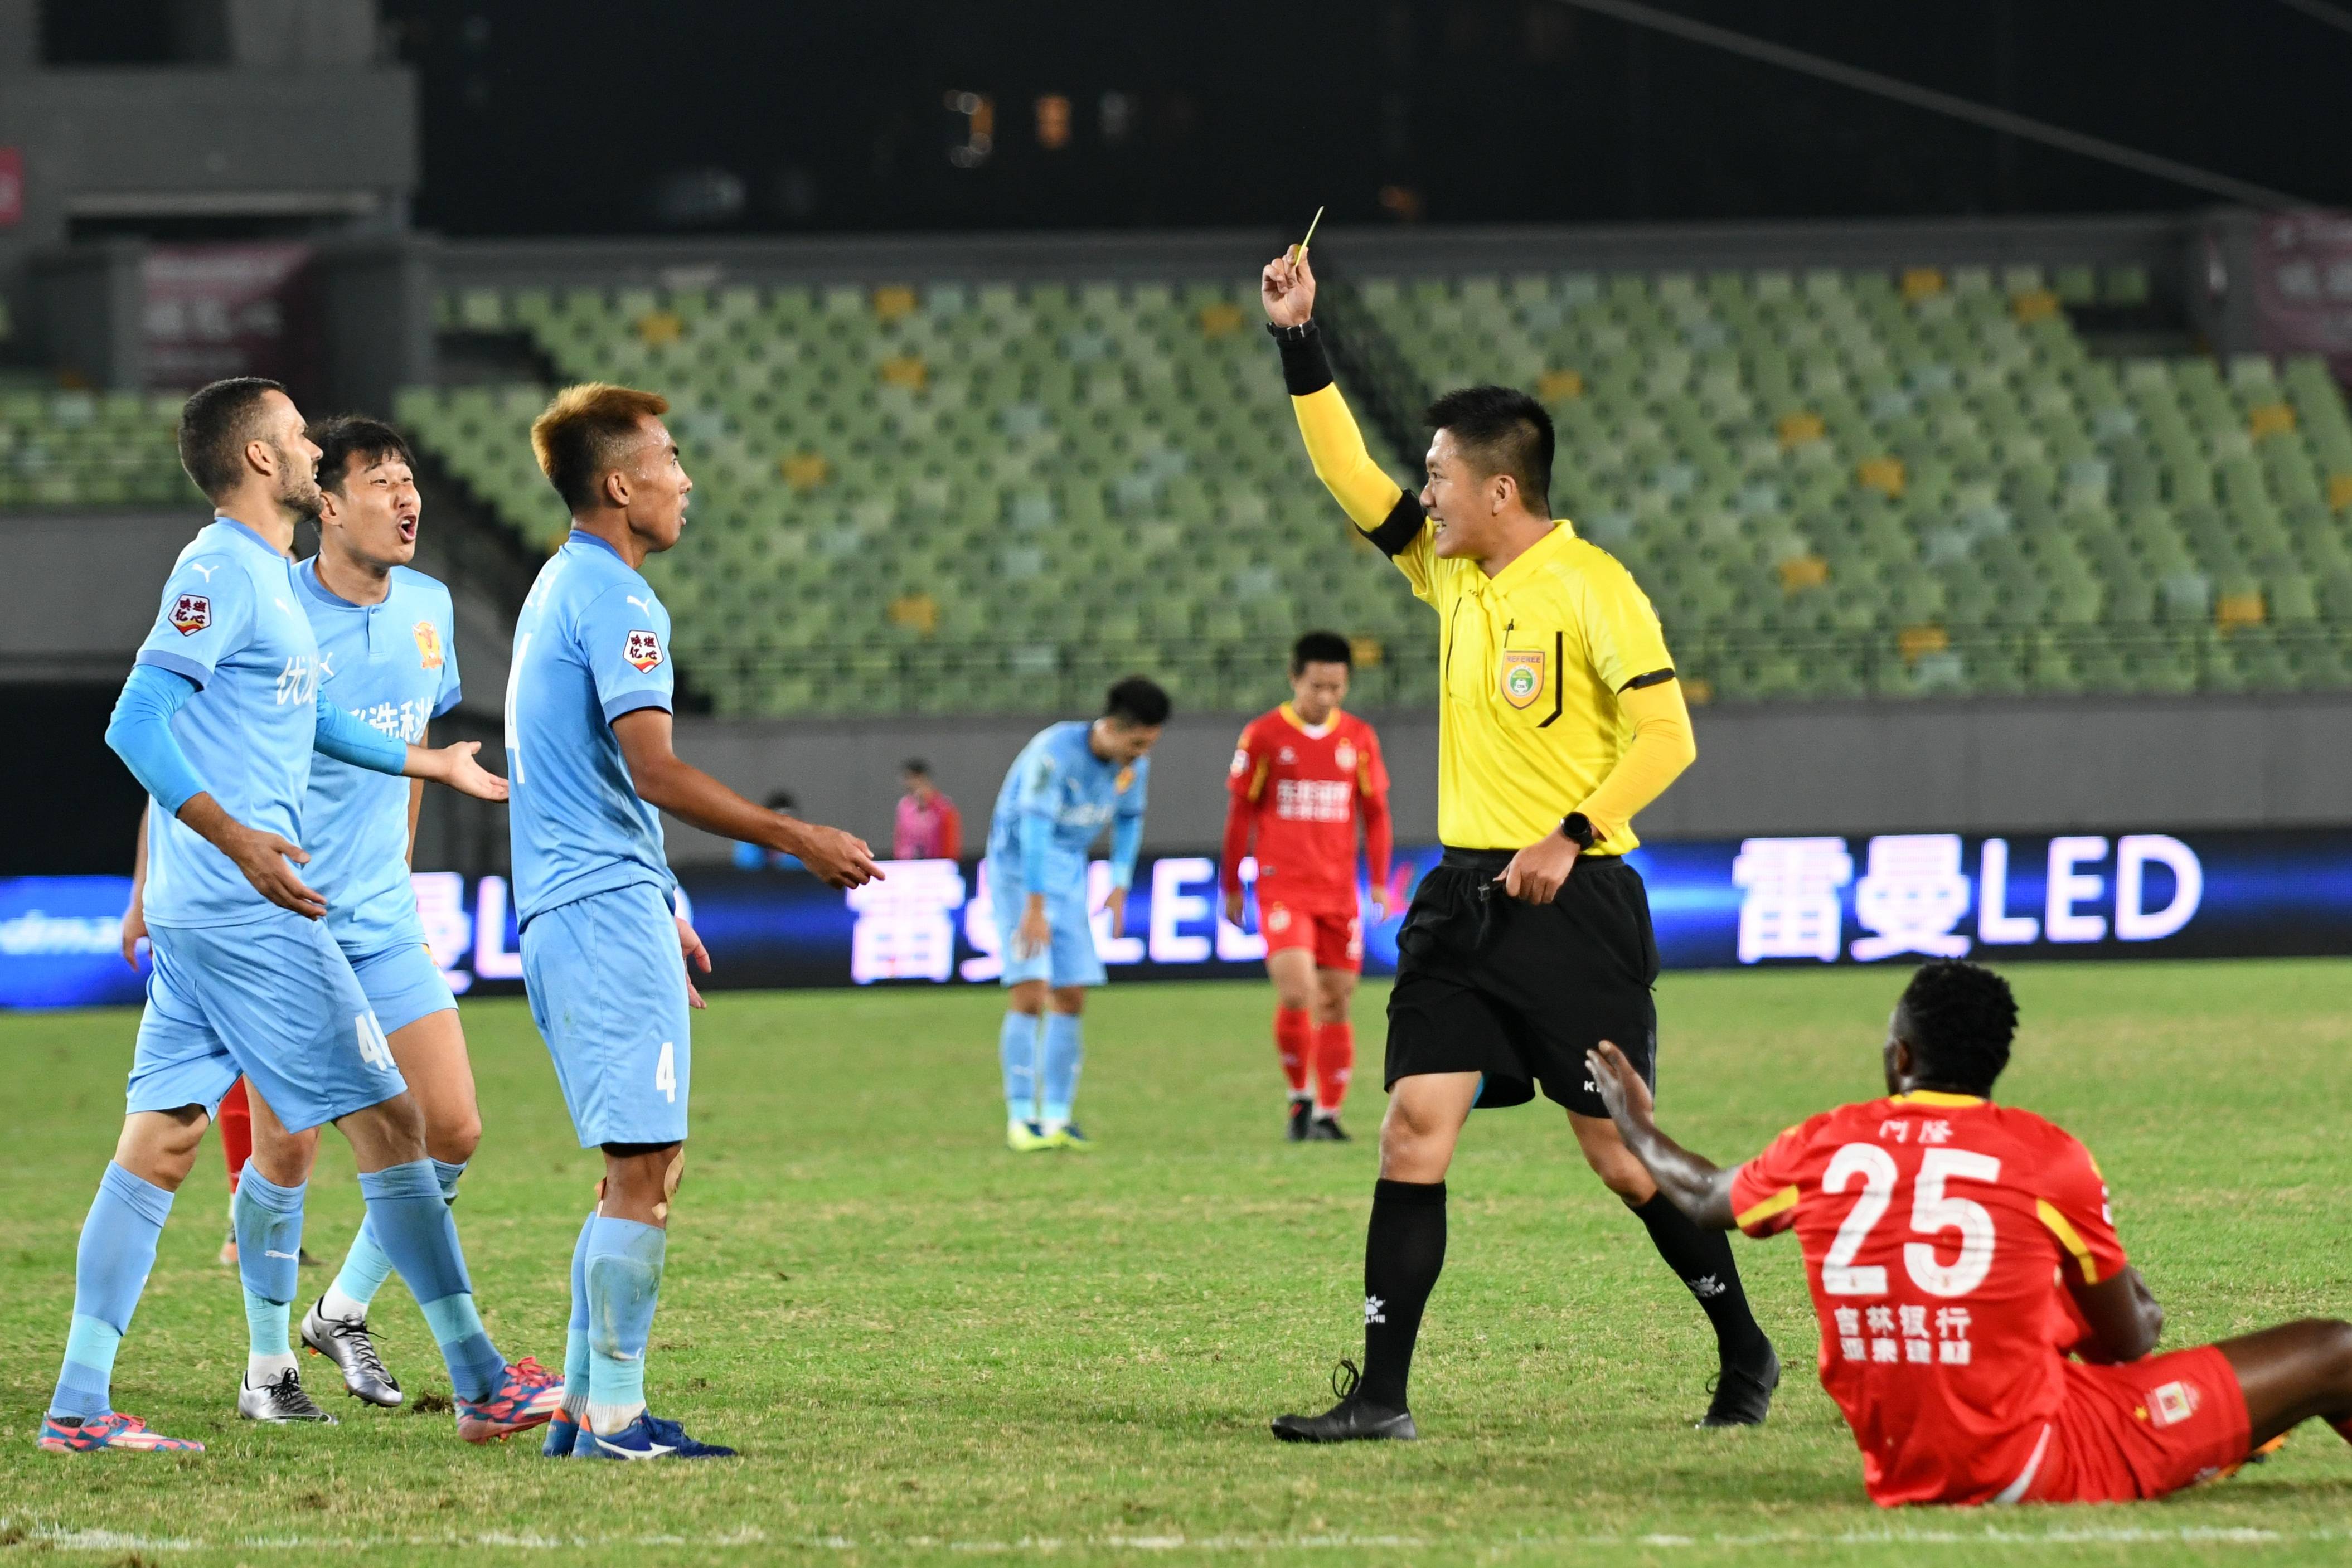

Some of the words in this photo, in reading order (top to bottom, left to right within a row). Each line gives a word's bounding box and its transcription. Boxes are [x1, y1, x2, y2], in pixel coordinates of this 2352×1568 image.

[1732, 833, 2204, 964] 雷曼LED
[655, 1041, 677, 1103] 4
[1821, 1142, 2001, 1298] 25
[1834, 1303, 1972, 1339] 吉林银行
